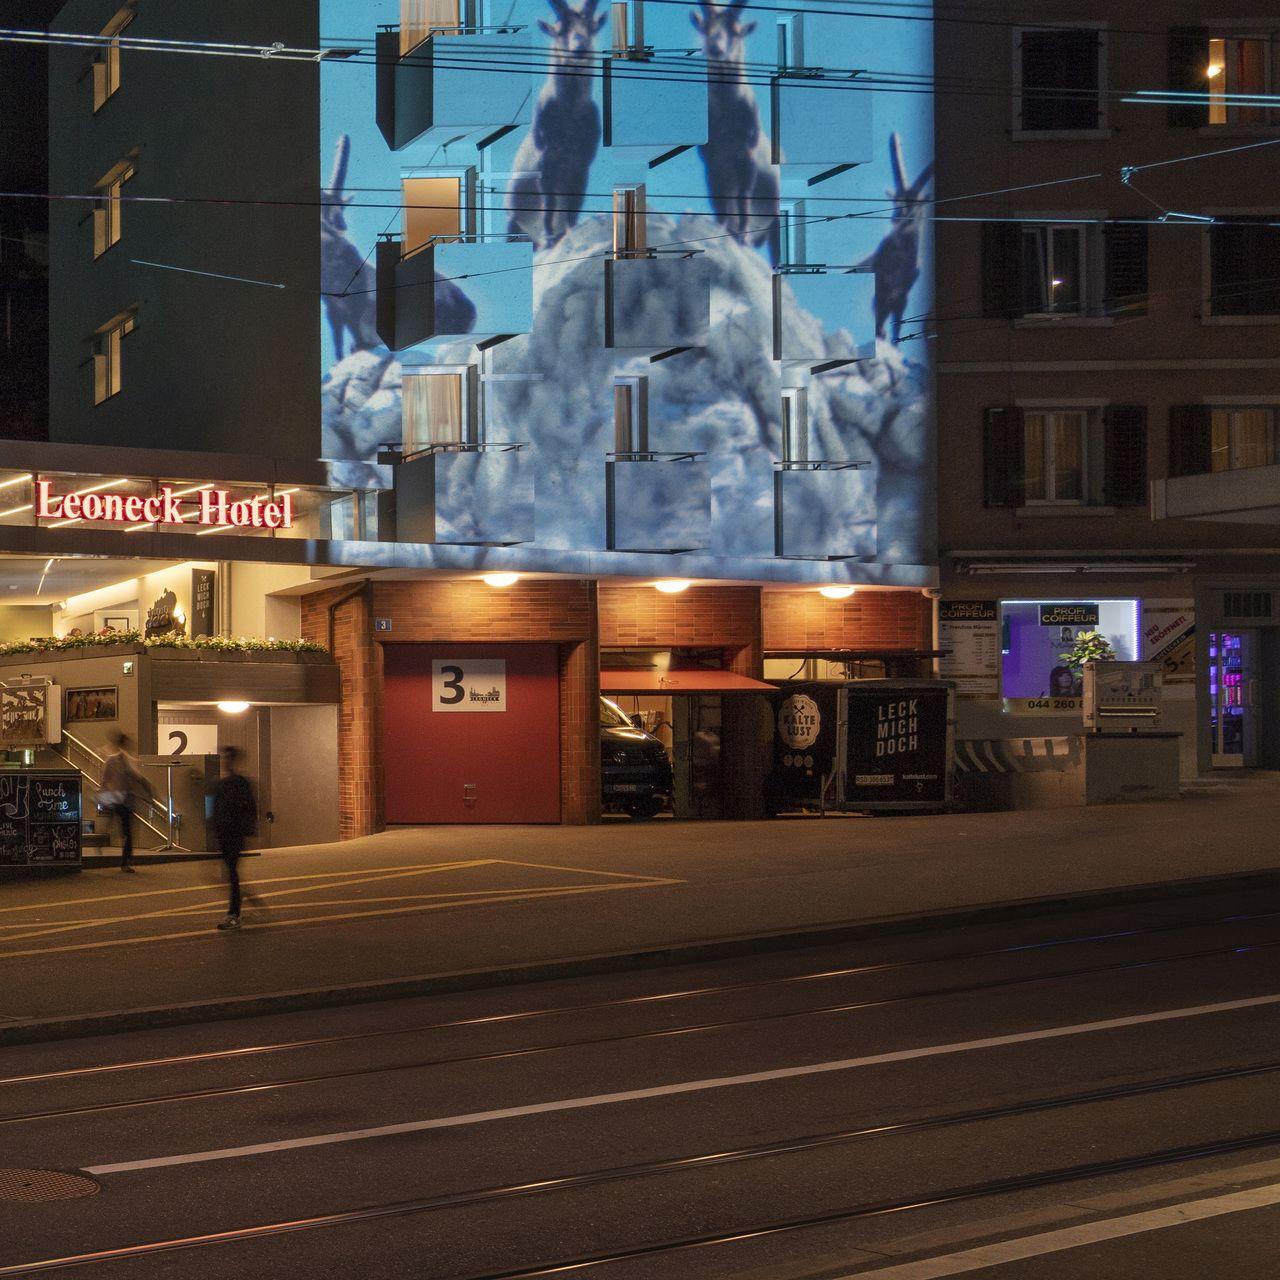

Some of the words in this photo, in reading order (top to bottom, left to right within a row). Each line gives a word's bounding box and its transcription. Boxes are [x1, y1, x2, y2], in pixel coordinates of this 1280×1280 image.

[36, 480, 183, 524] Leoneck
[199, 489, 293, 528] Hotel
[941, 610, 994, 618] COIFFEUR
[1042, 614, 1097, 622] COIFFEUR
[1053, 607, 1086, 615] PROFI
[380, 620, 387, 630] 3
[1143, 624, 1160, 639] NEU
[439, 665, 466, 705] 3
[878, 698, 919, 721] LECK
[1028, 700, 1050, 708] 044
[1054, 700, 1075, 709] 260
[787, 726, 812, 737] LUST
[877, 717, 918, 739] MICH
[169, 730, 188, 756] 2
[876, 734, 918, 757] DOCH
